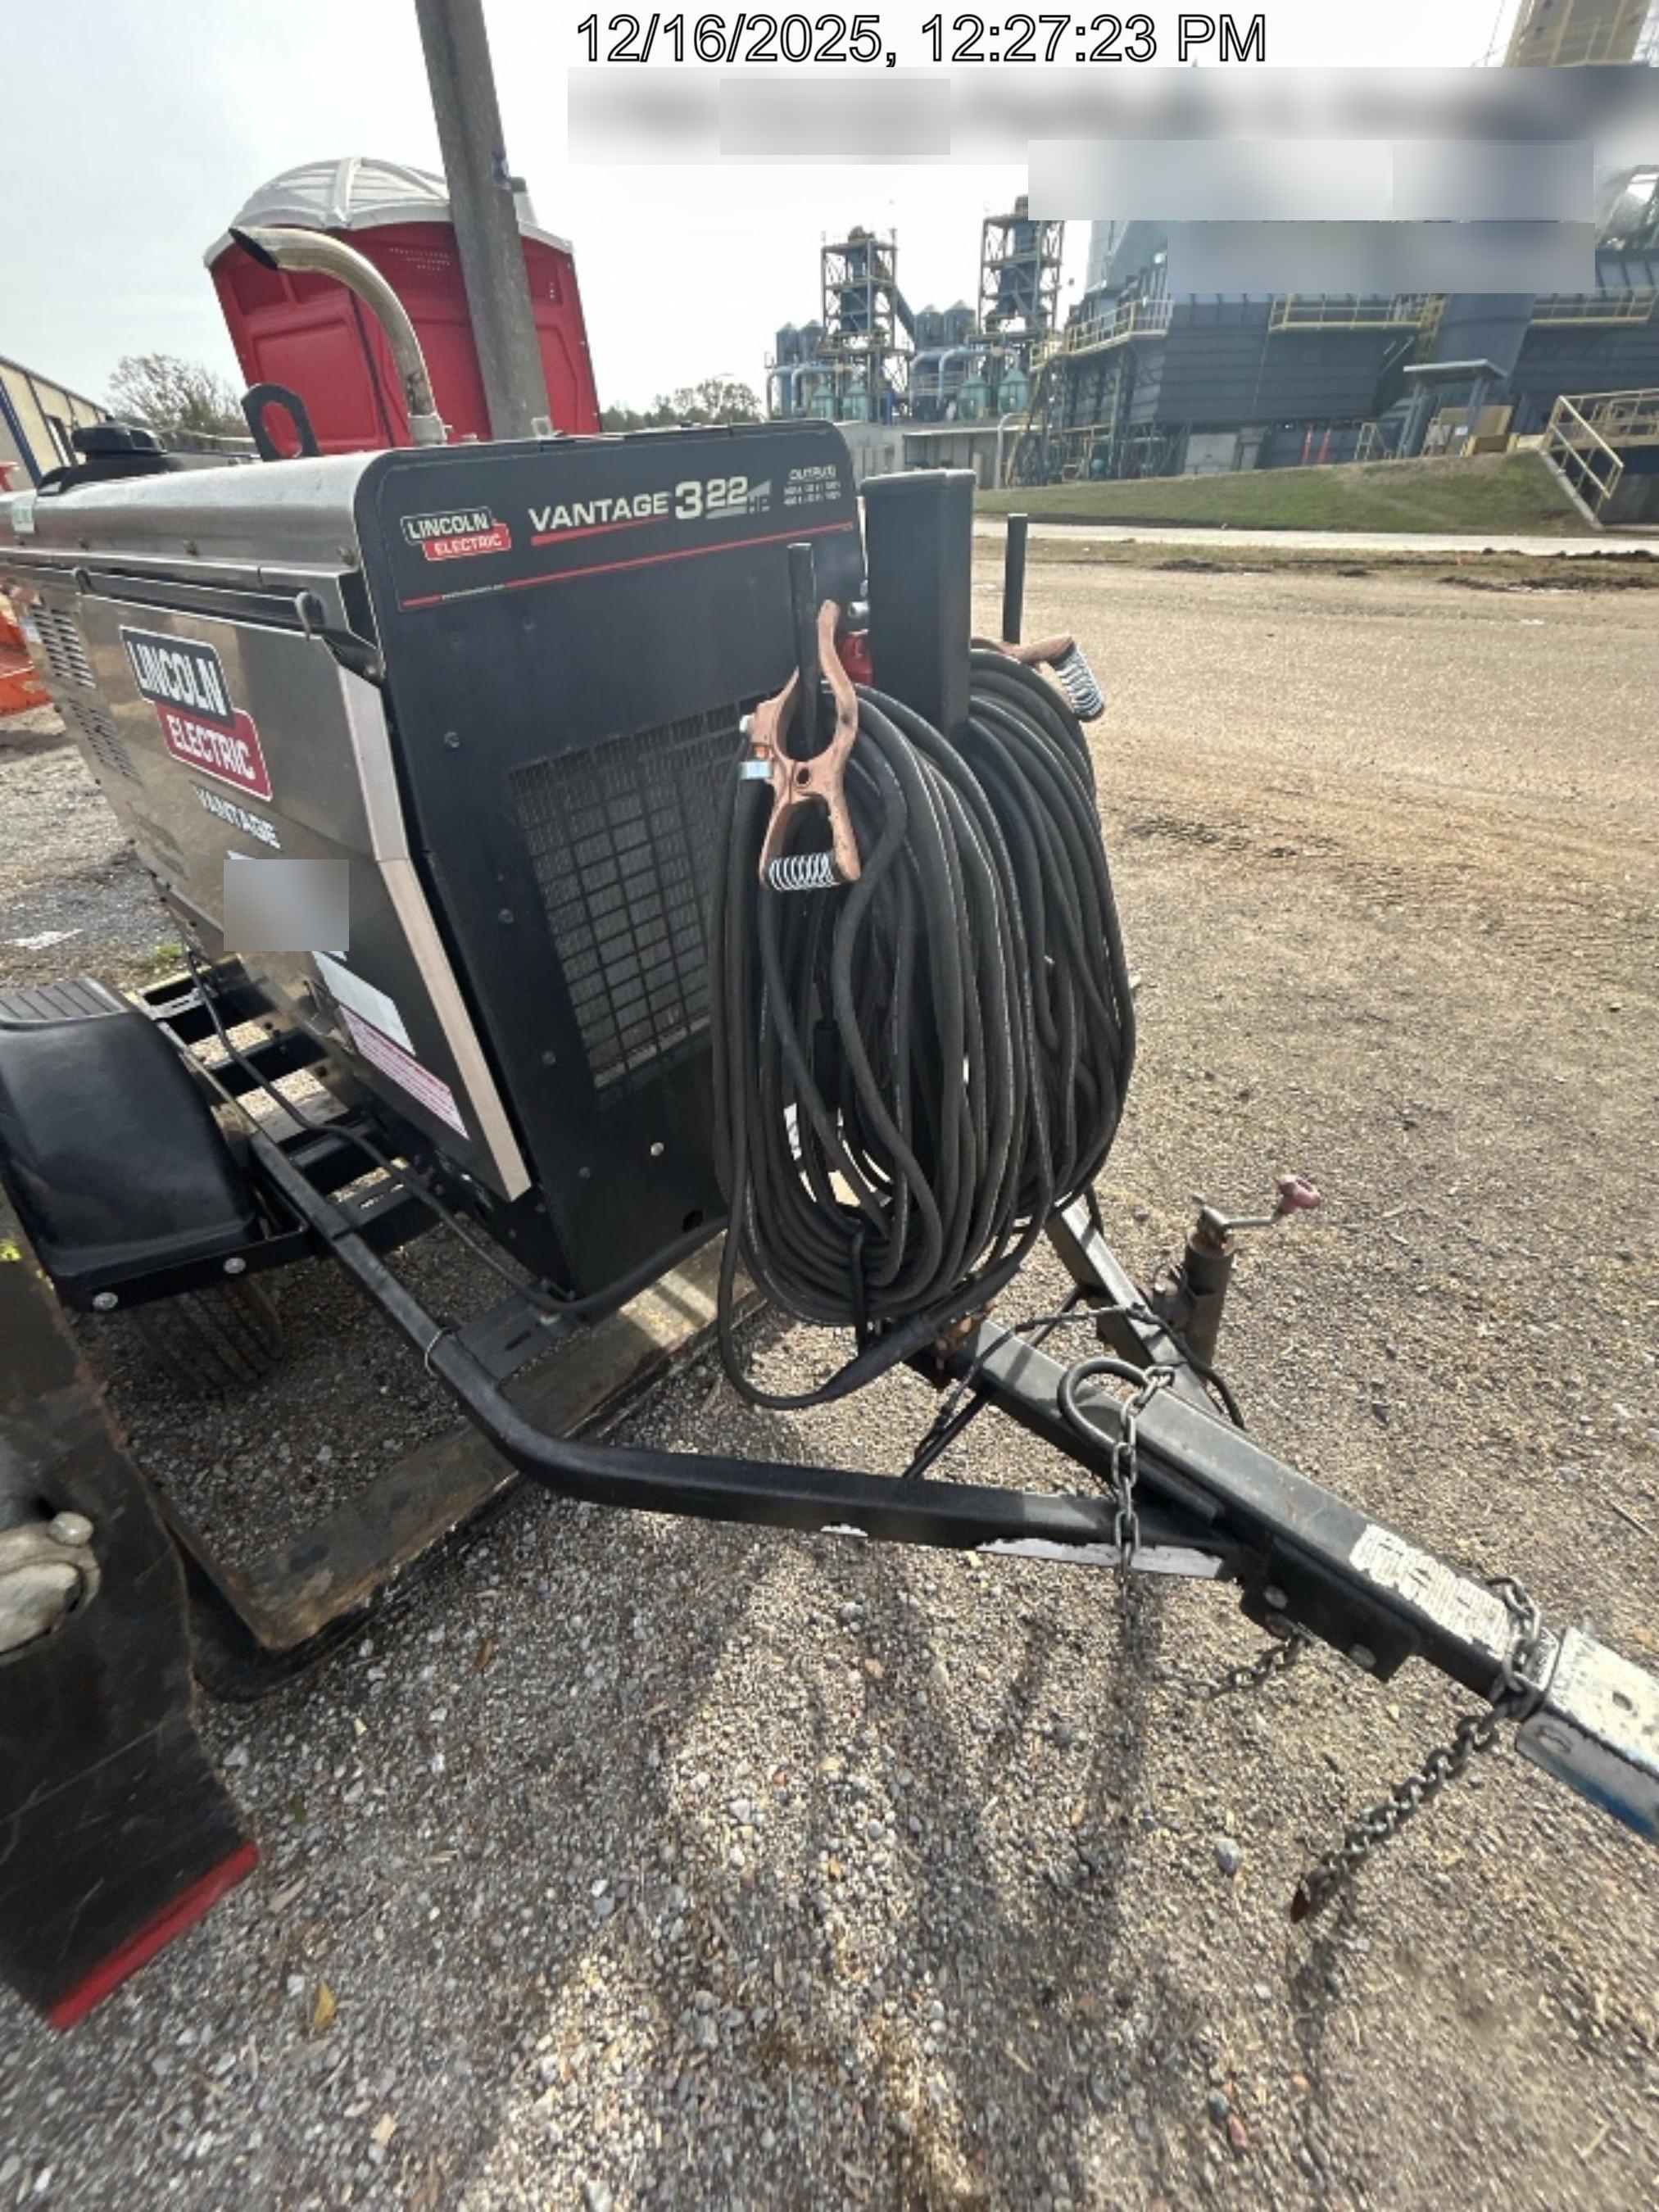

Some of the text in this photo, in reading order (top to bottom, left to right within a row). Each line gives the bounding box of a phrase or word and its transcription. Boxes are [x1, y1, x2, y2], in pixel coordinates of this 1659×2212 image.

[407, 512, 491, 540] LINCOLN
[528, 492, 670, 533] VANTAGE
[675, 476, 749, 520] 322
[433, 533, 502, 556] ELECTRIC
[127, 641, 228, 717] LINCOLN
[166, 714, 256, 781] ELECTRIC
[194, 785, 282, 850] VANTAGE
